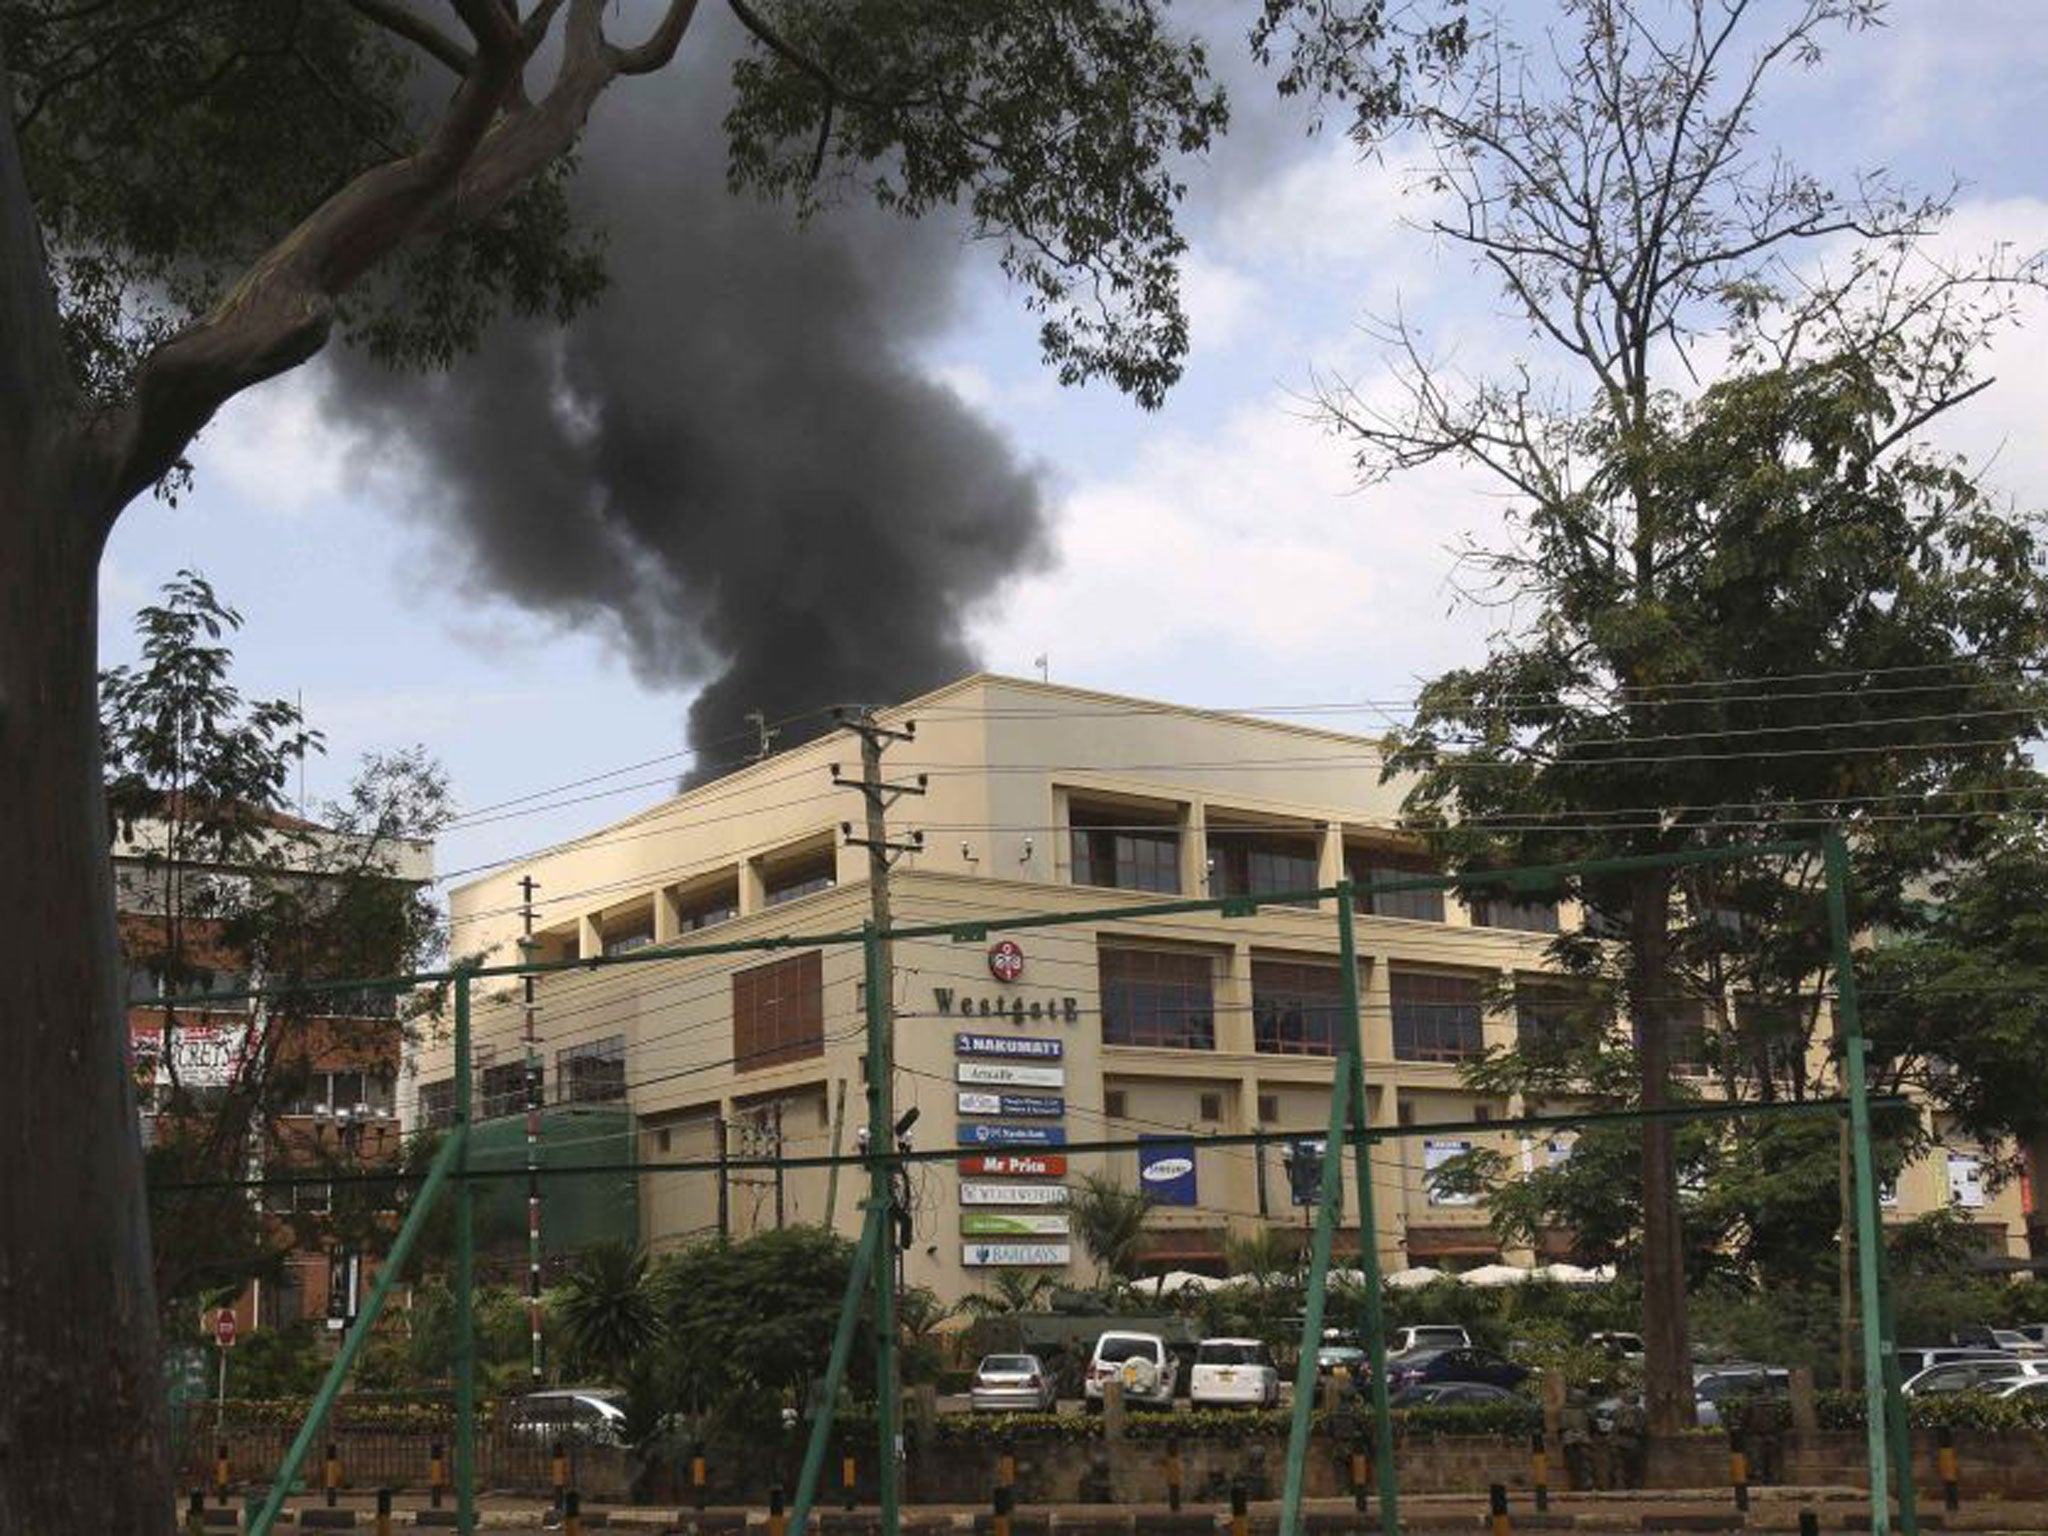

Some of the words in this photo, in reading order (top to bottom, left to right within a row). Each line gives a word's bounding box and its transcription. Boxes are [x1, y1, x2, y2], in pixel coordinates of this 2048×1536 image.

[971, 1038, 1061, 1056] NAKUMATT
[983, 1156, 1006, 1172] Mr
[1009, 1157, 1046, 1174] Price
[992, 1246, 1059, 1264] BARCLAYS
